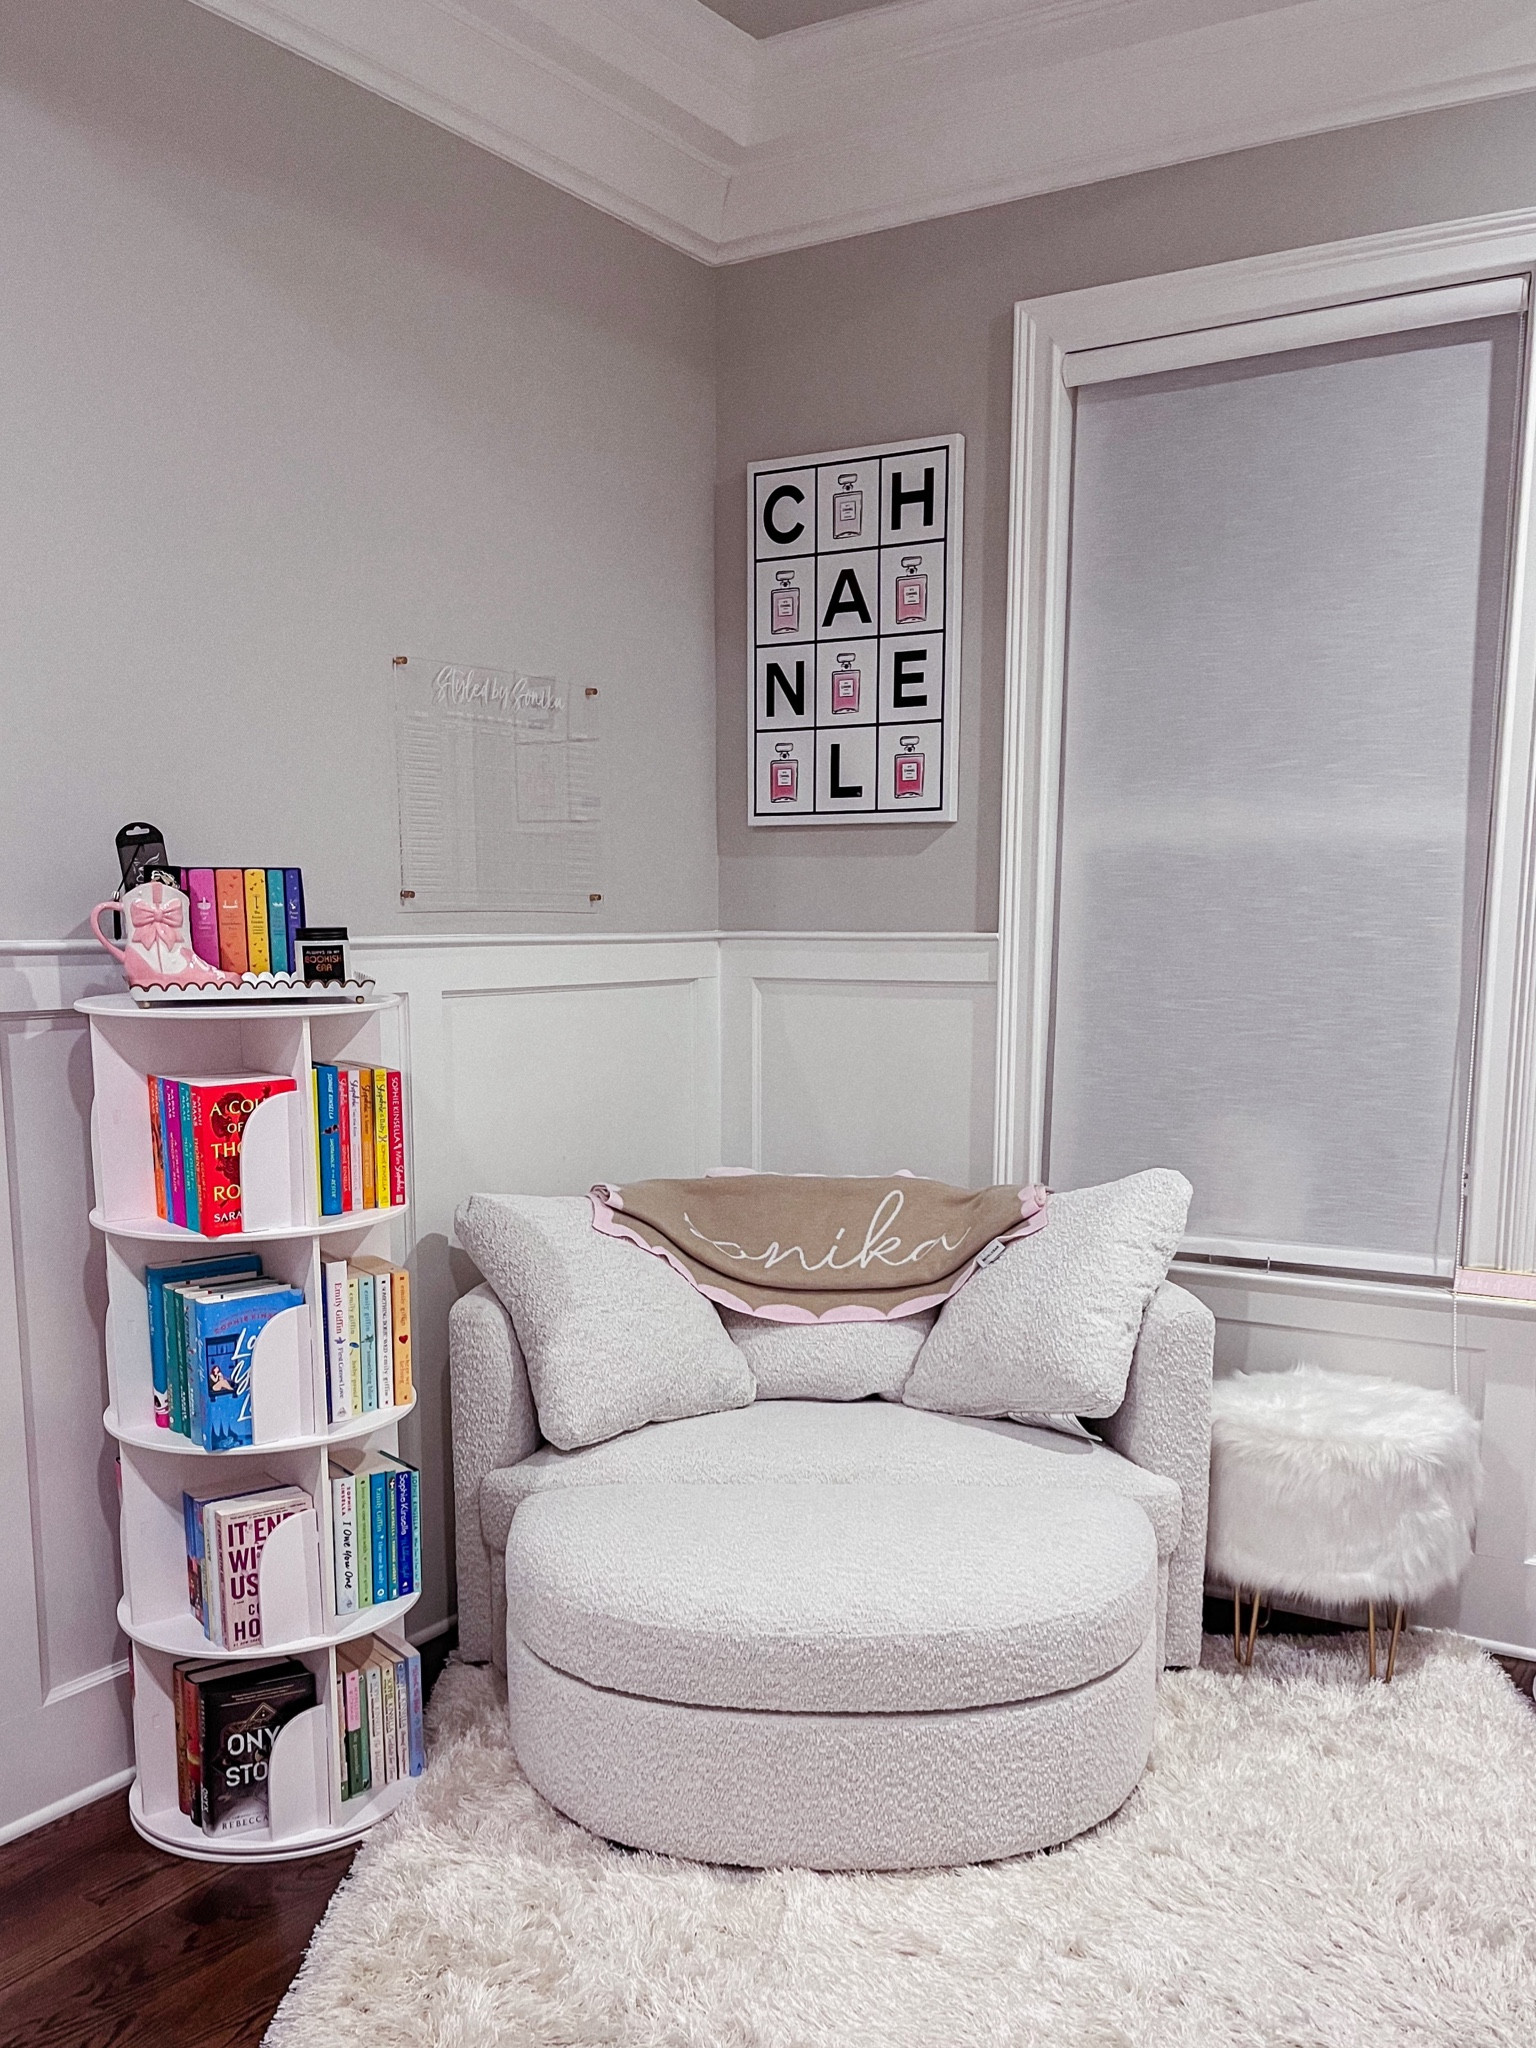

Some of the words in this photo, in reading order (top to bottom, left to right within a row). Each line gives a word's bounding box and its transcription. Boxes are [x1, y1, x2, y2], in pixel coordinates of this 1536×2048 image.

[763, 485, 805, 544] C
[891, 468, 934, 530] H
[822, 569, 872, 627] A
[766, 660, 804, 717] N
[893, 649, 927, 708] E
[830, 743, 863, 798] L
[305, 955, 341, 963] BOOKISH
[316, 964, 332, 972] ERA
[392, 1077, 400, 1105] SOPHIE
[210, 1102, 222, 1116] A
[227, 1122, 244, 1133] OF
[393, 1107, 401, 1143] KINSELLA
[334, 1283, 342, 1308] Emily
[398, 1474, 408, 1502] Sophie
[228, 1521, 247, 1547] IT
[344, 1529, 352, 1547] Owe
[345, 1571, 353, 1589] One
